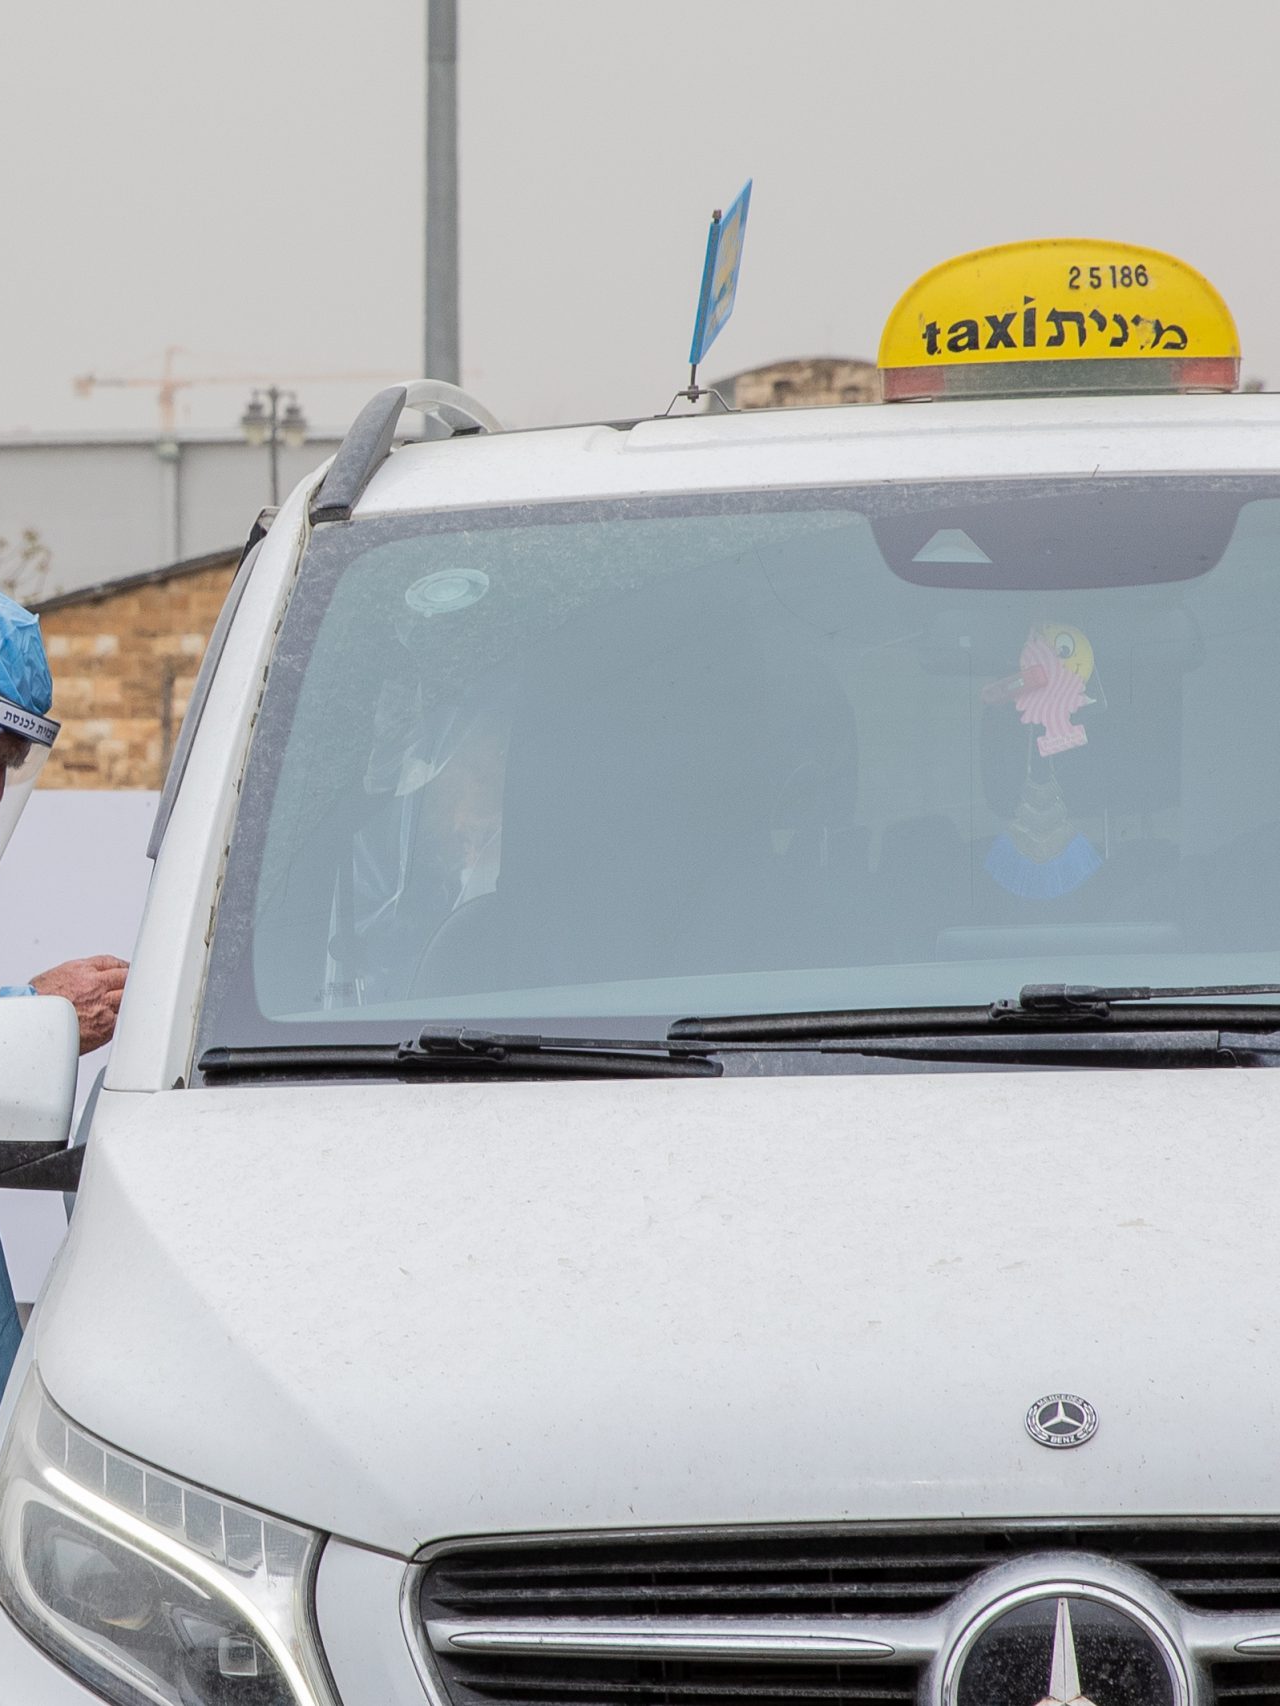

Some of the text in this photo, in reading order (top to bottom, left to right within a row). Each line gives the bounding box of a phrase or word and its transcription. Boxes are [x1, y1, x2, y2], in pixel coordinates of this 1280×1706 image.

[1068, 264, 1149, 289] 25186
[922, 295, 1036, 356] taxi
[3, 710, 36, 730] לכנסת
